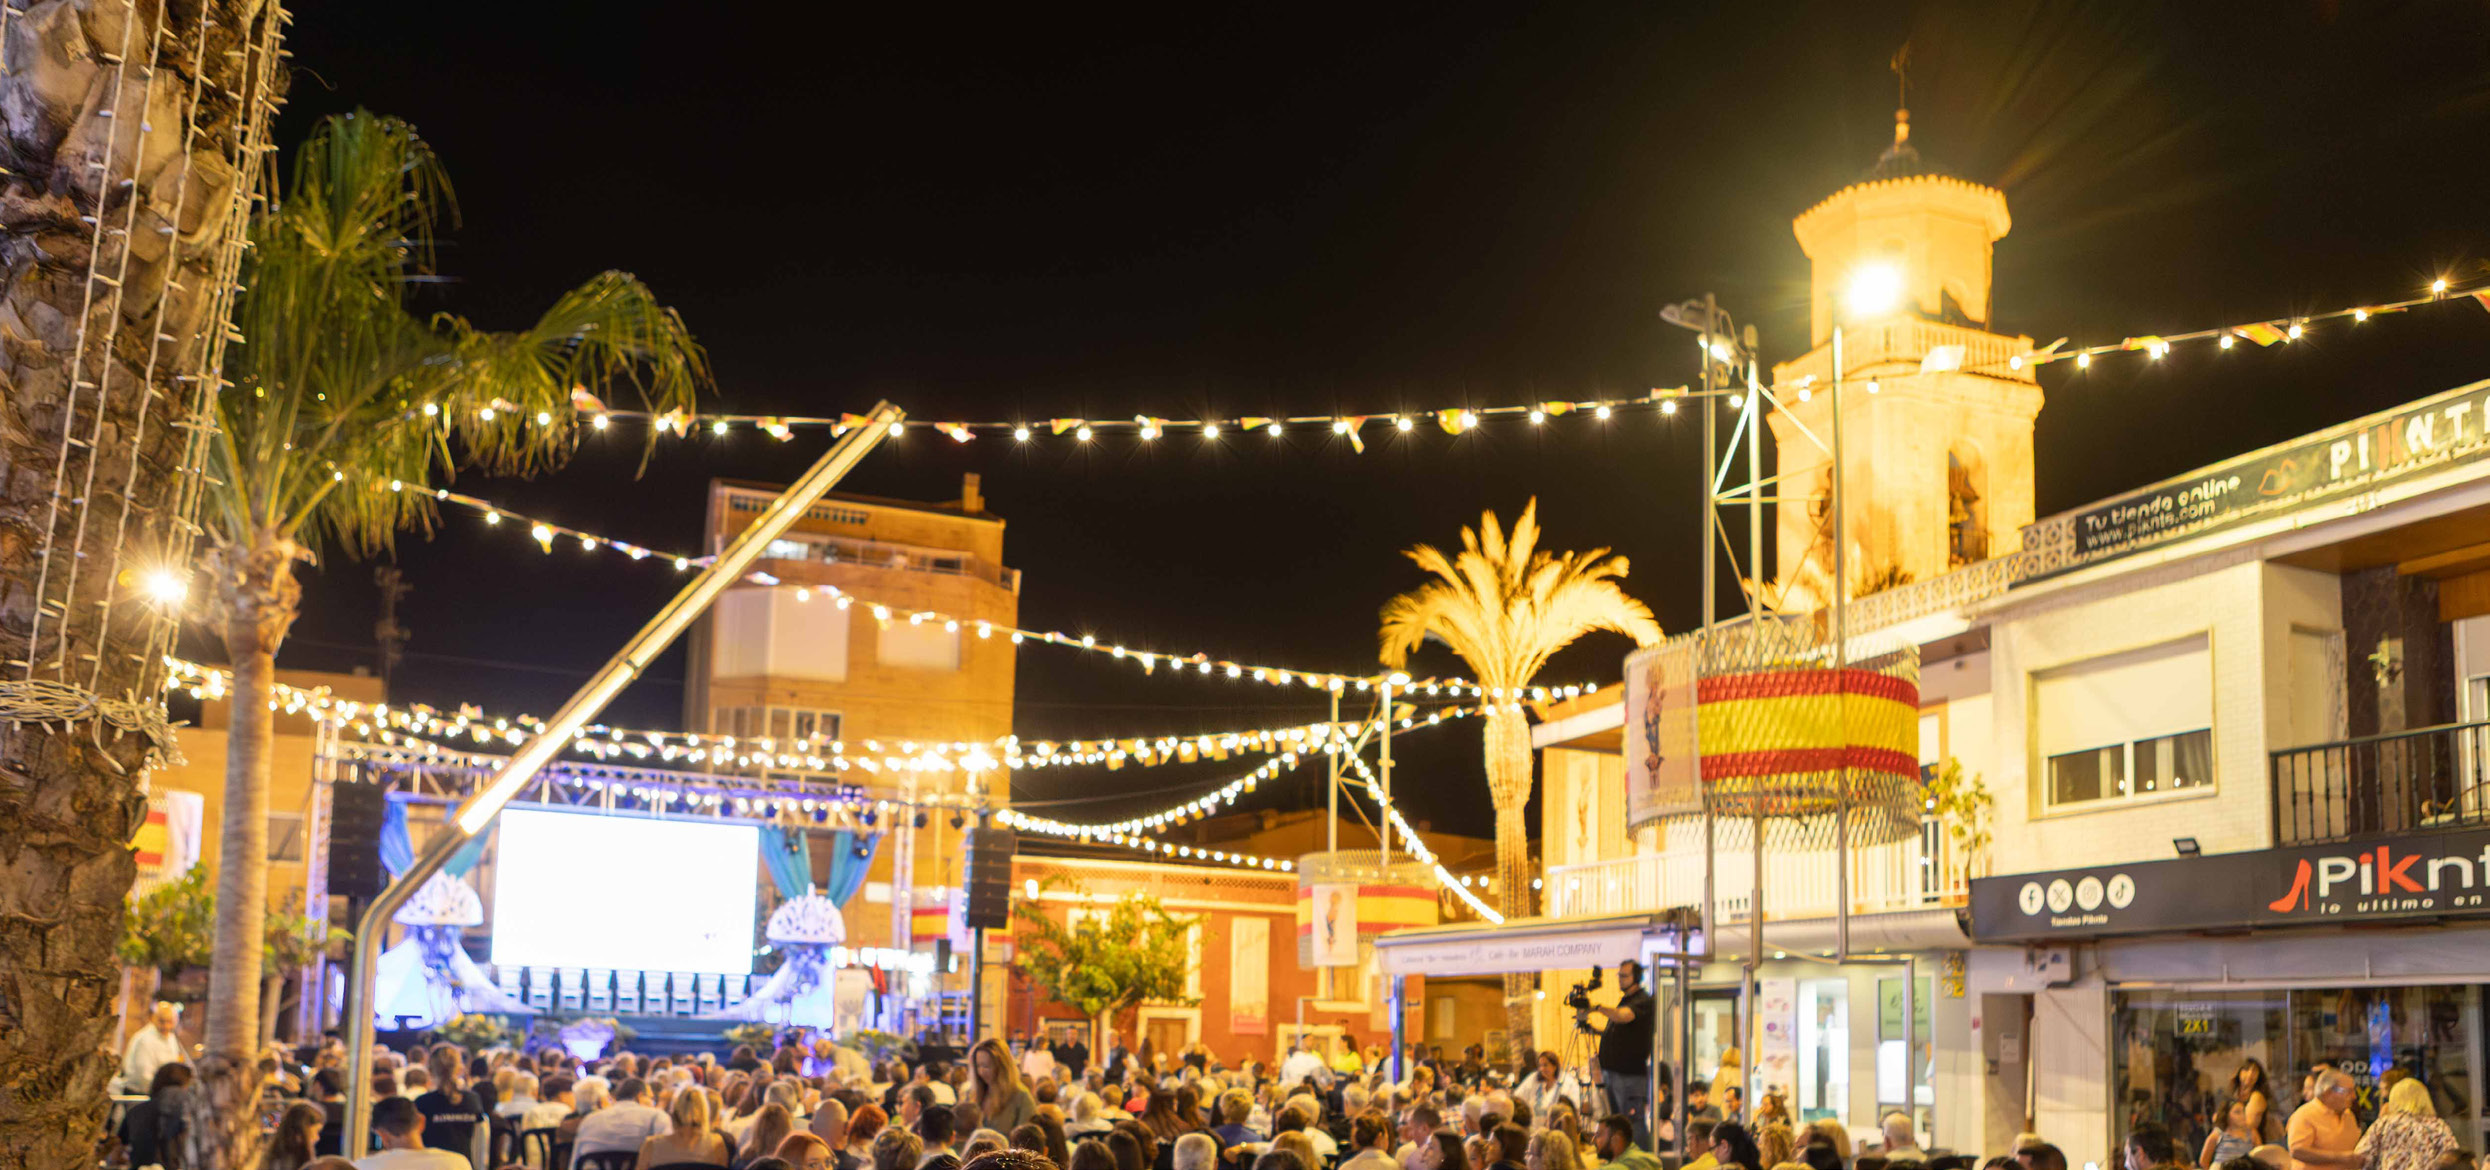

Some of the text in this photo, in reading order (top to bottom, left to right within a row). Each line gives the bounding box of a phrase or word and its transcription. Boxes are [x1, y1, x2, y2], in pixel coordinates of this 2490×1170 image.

[2329, 395, 2490, 481] PIKNT
[2085, 475, 2241, 532] Tu tienda online
[2454, 894, 2483, 907] en
[1556, 942, 1602, 957] COMPANY
